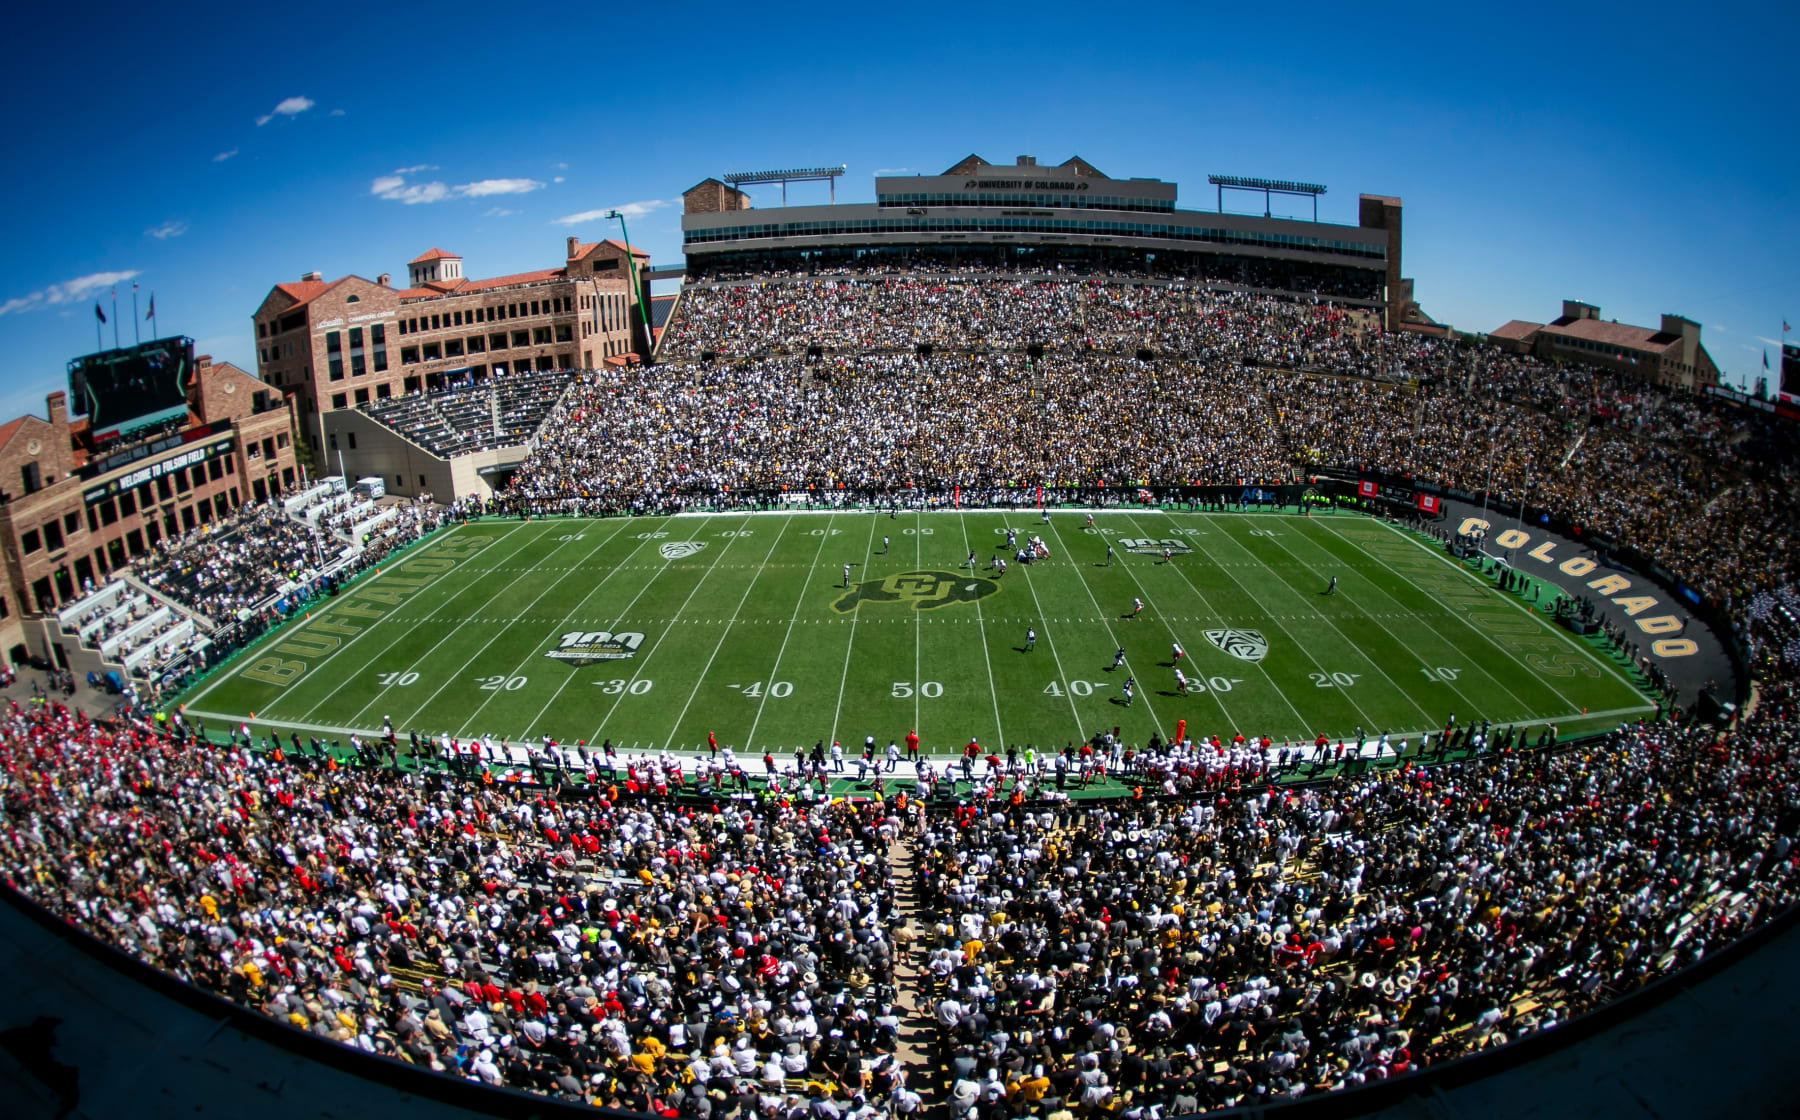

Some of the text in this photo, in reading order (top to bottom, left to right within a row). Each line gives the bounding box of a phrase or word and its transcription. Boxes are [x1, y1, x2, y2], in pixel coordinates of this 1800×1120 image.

[978, 180, 1075, 191] UNIVERSITY OF COLORADO
[120, 448, 205, 490] WELCOME TO FOLSOM FIELD
[881, 574, 956, 600] CU
[1457, 517, 1699, 657] COLORADO
[239, 535, 494, 687] BUFFALOES
[560, 631, 645, 650] 100
[1233, 646, 1261, 656] 12
[378, 671, 420, 686] 10
[479, 675, 528, 691] 20
[1308, 672, 1354, 688] 20
[1420, 667, 1458, 682] 10
[602, 679, 653, 695] 30
[742, 681, 794, 698] 40
[891, 681, 944, 698] 50
[1043, 680, 1093, 697] 40
[1185, 676, 1232, 693] 30
